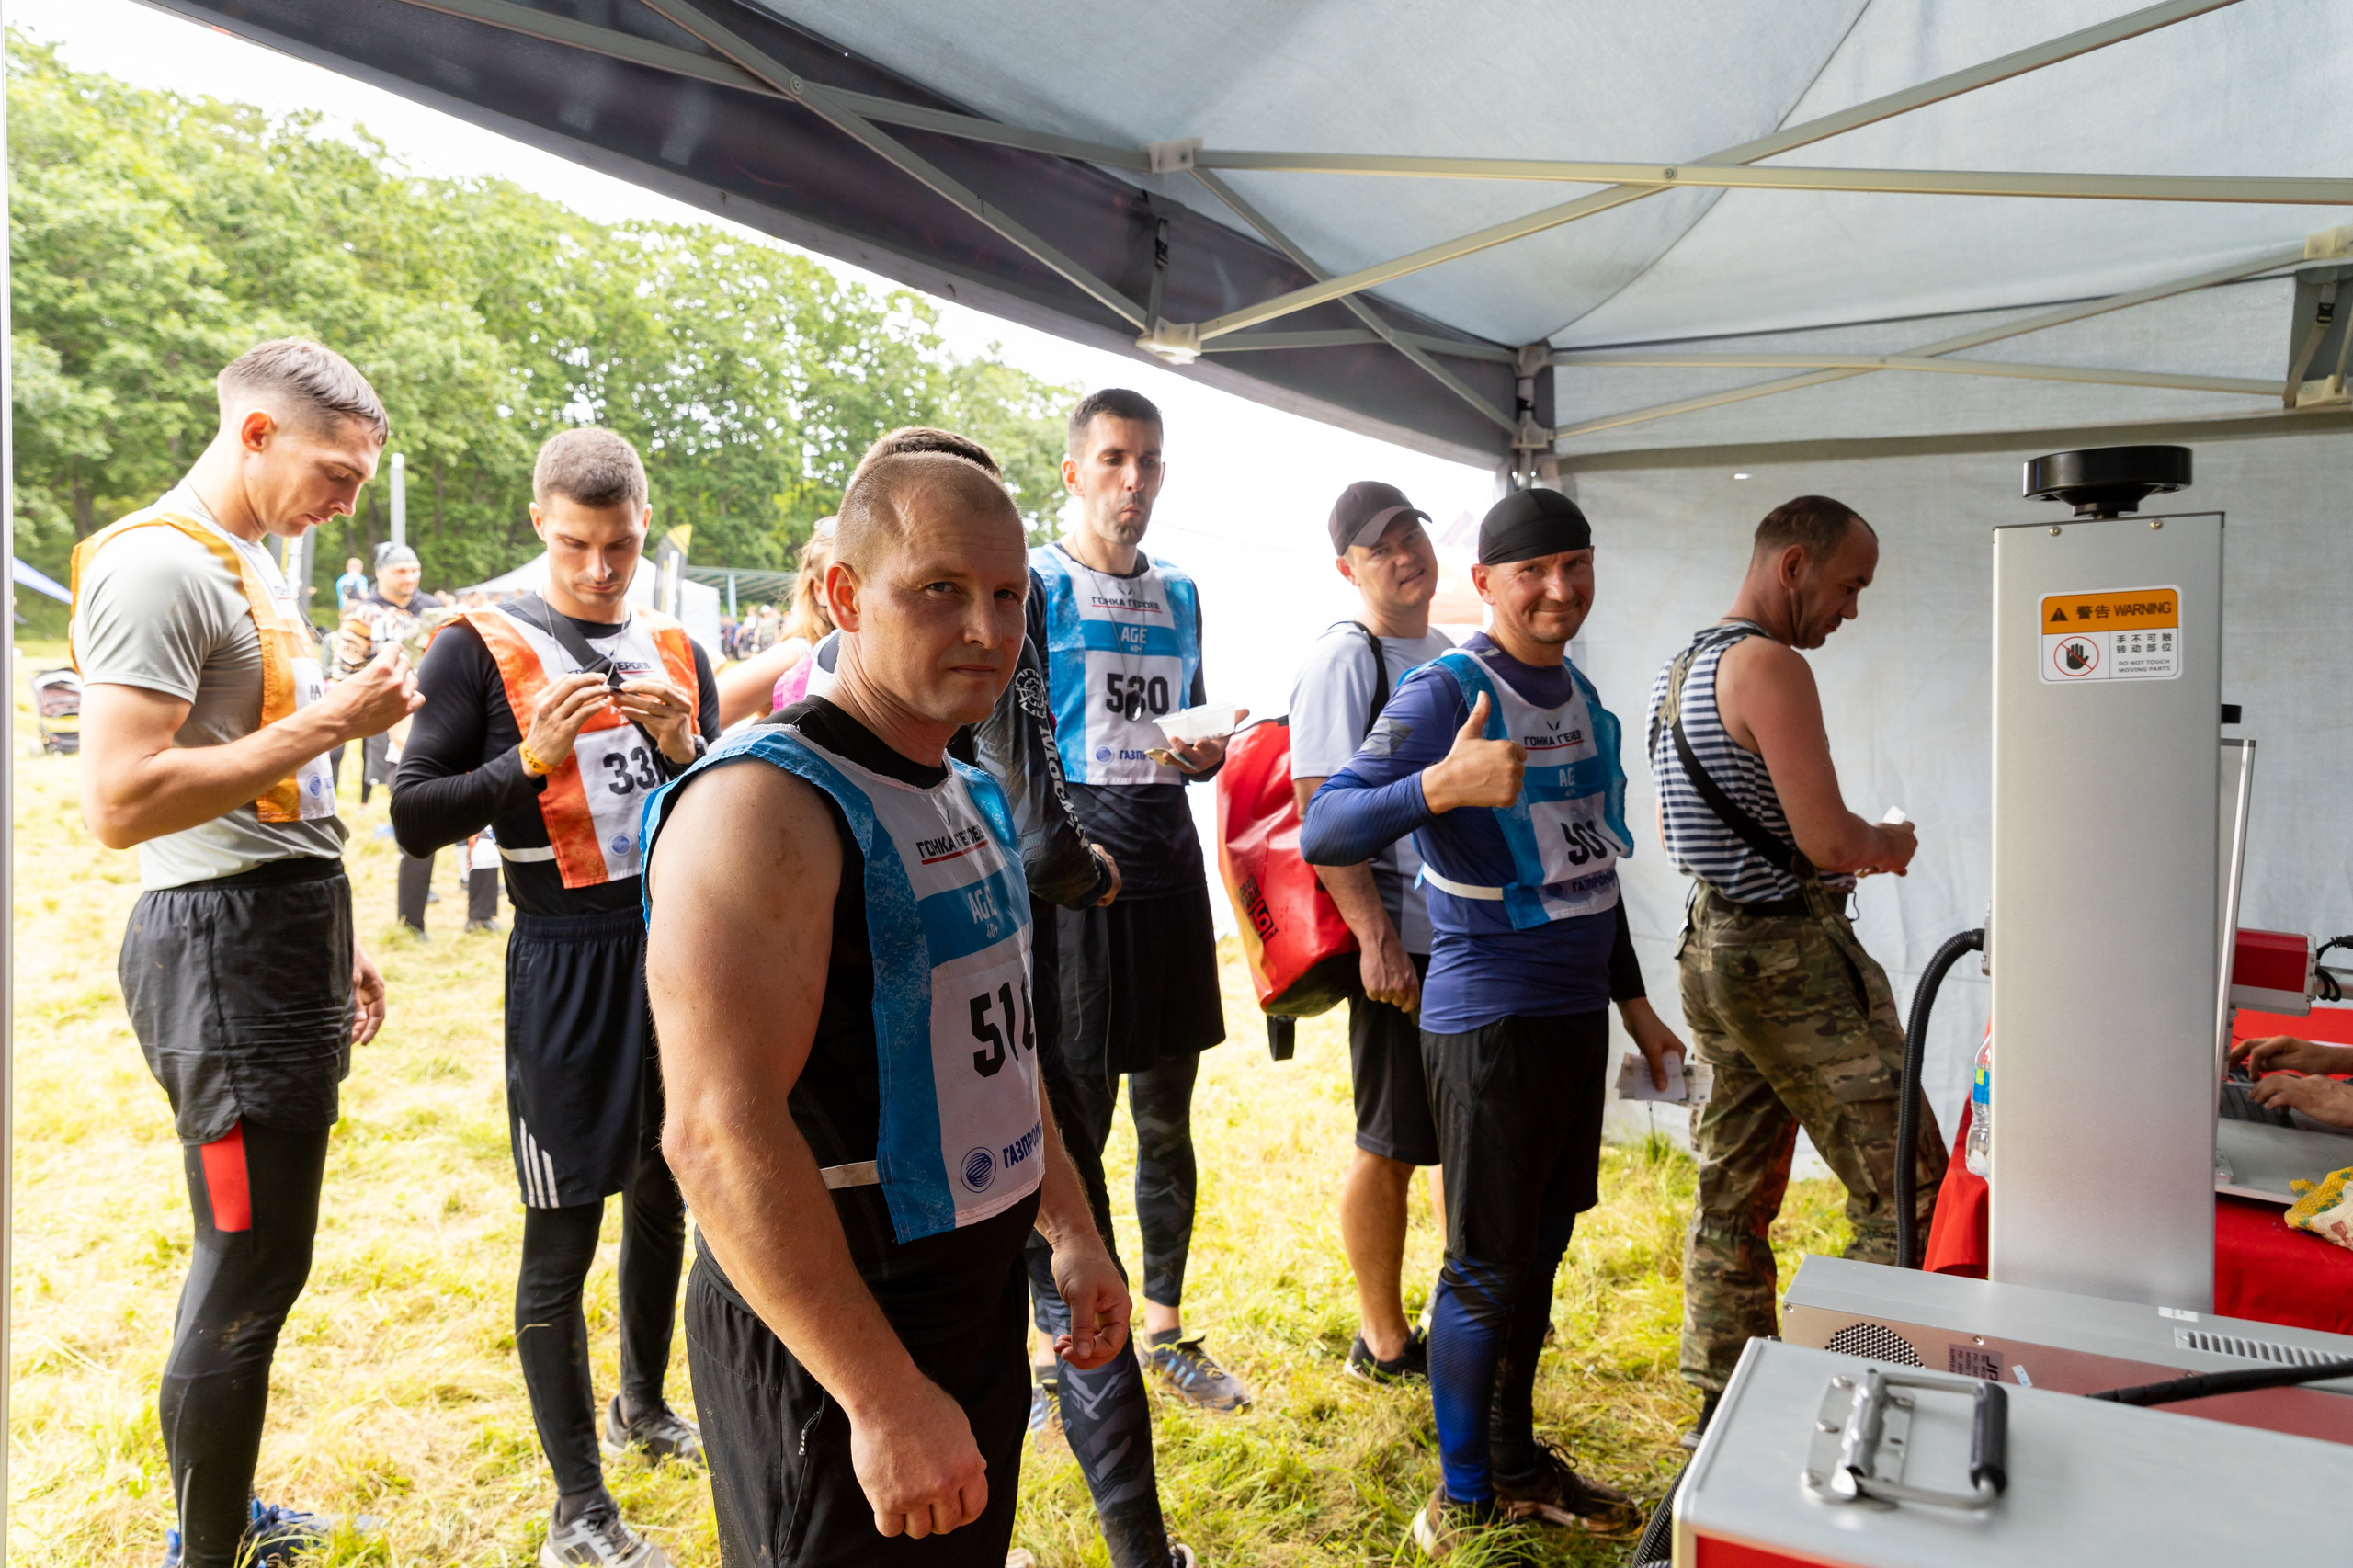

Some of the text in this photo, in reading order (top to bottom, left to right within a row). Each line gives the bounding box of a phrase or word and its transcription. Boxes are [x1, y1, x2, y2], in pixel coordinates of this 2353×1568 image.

[2076, 601, 2172, 619] 警告 WARNING
[1120, 626, 1147, 644] AGE
[1524, 736, 1555, 746] ГОНКА
[916, 834, 958, 858] ГОНКА
[968, 885, 997, 925] AGE
